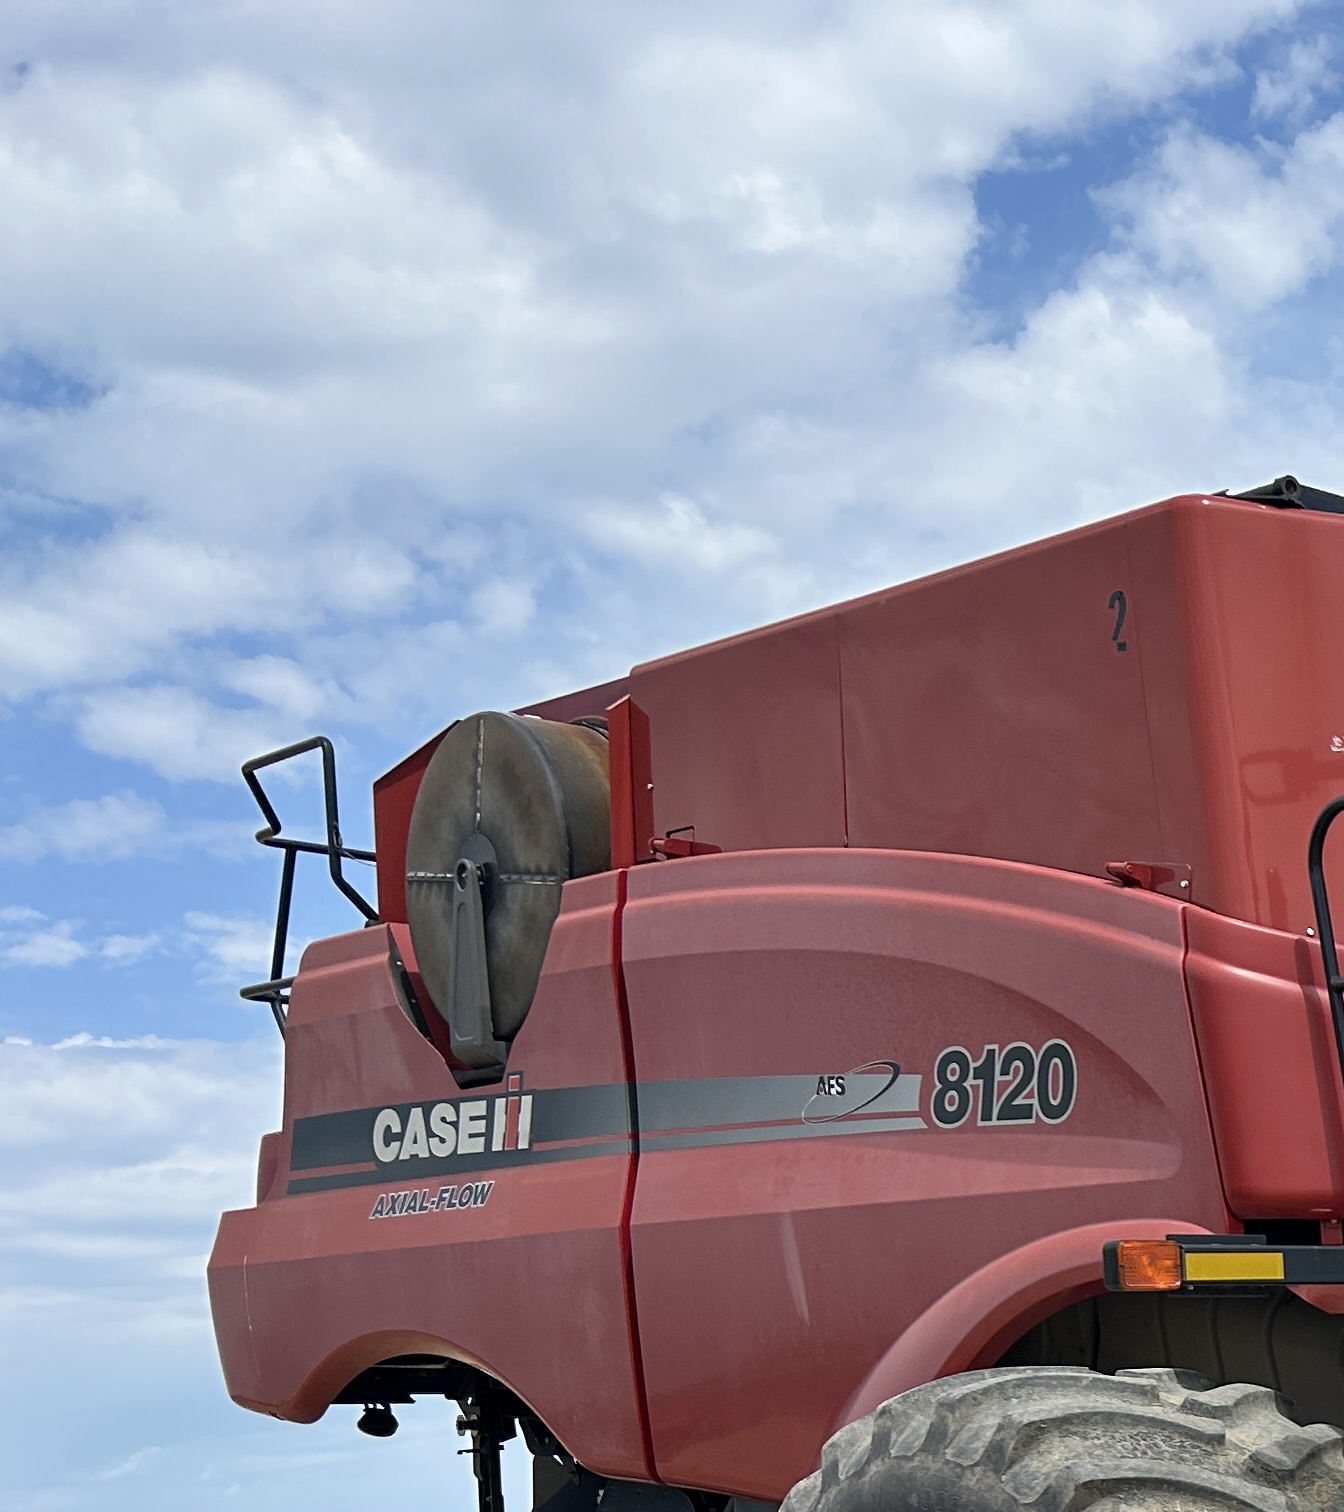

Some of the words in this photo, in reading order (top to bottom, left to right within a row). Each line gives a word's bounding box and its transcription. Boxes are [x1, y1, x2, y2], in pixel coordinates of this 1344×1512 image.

[816, 1075, 846, 1096] AFS
[930, 1038, 1077, 1129] 8120
[373, 1100, 488, 1163] CASE
[368, 1180, 496, 1220] AXIAL-FLOW
